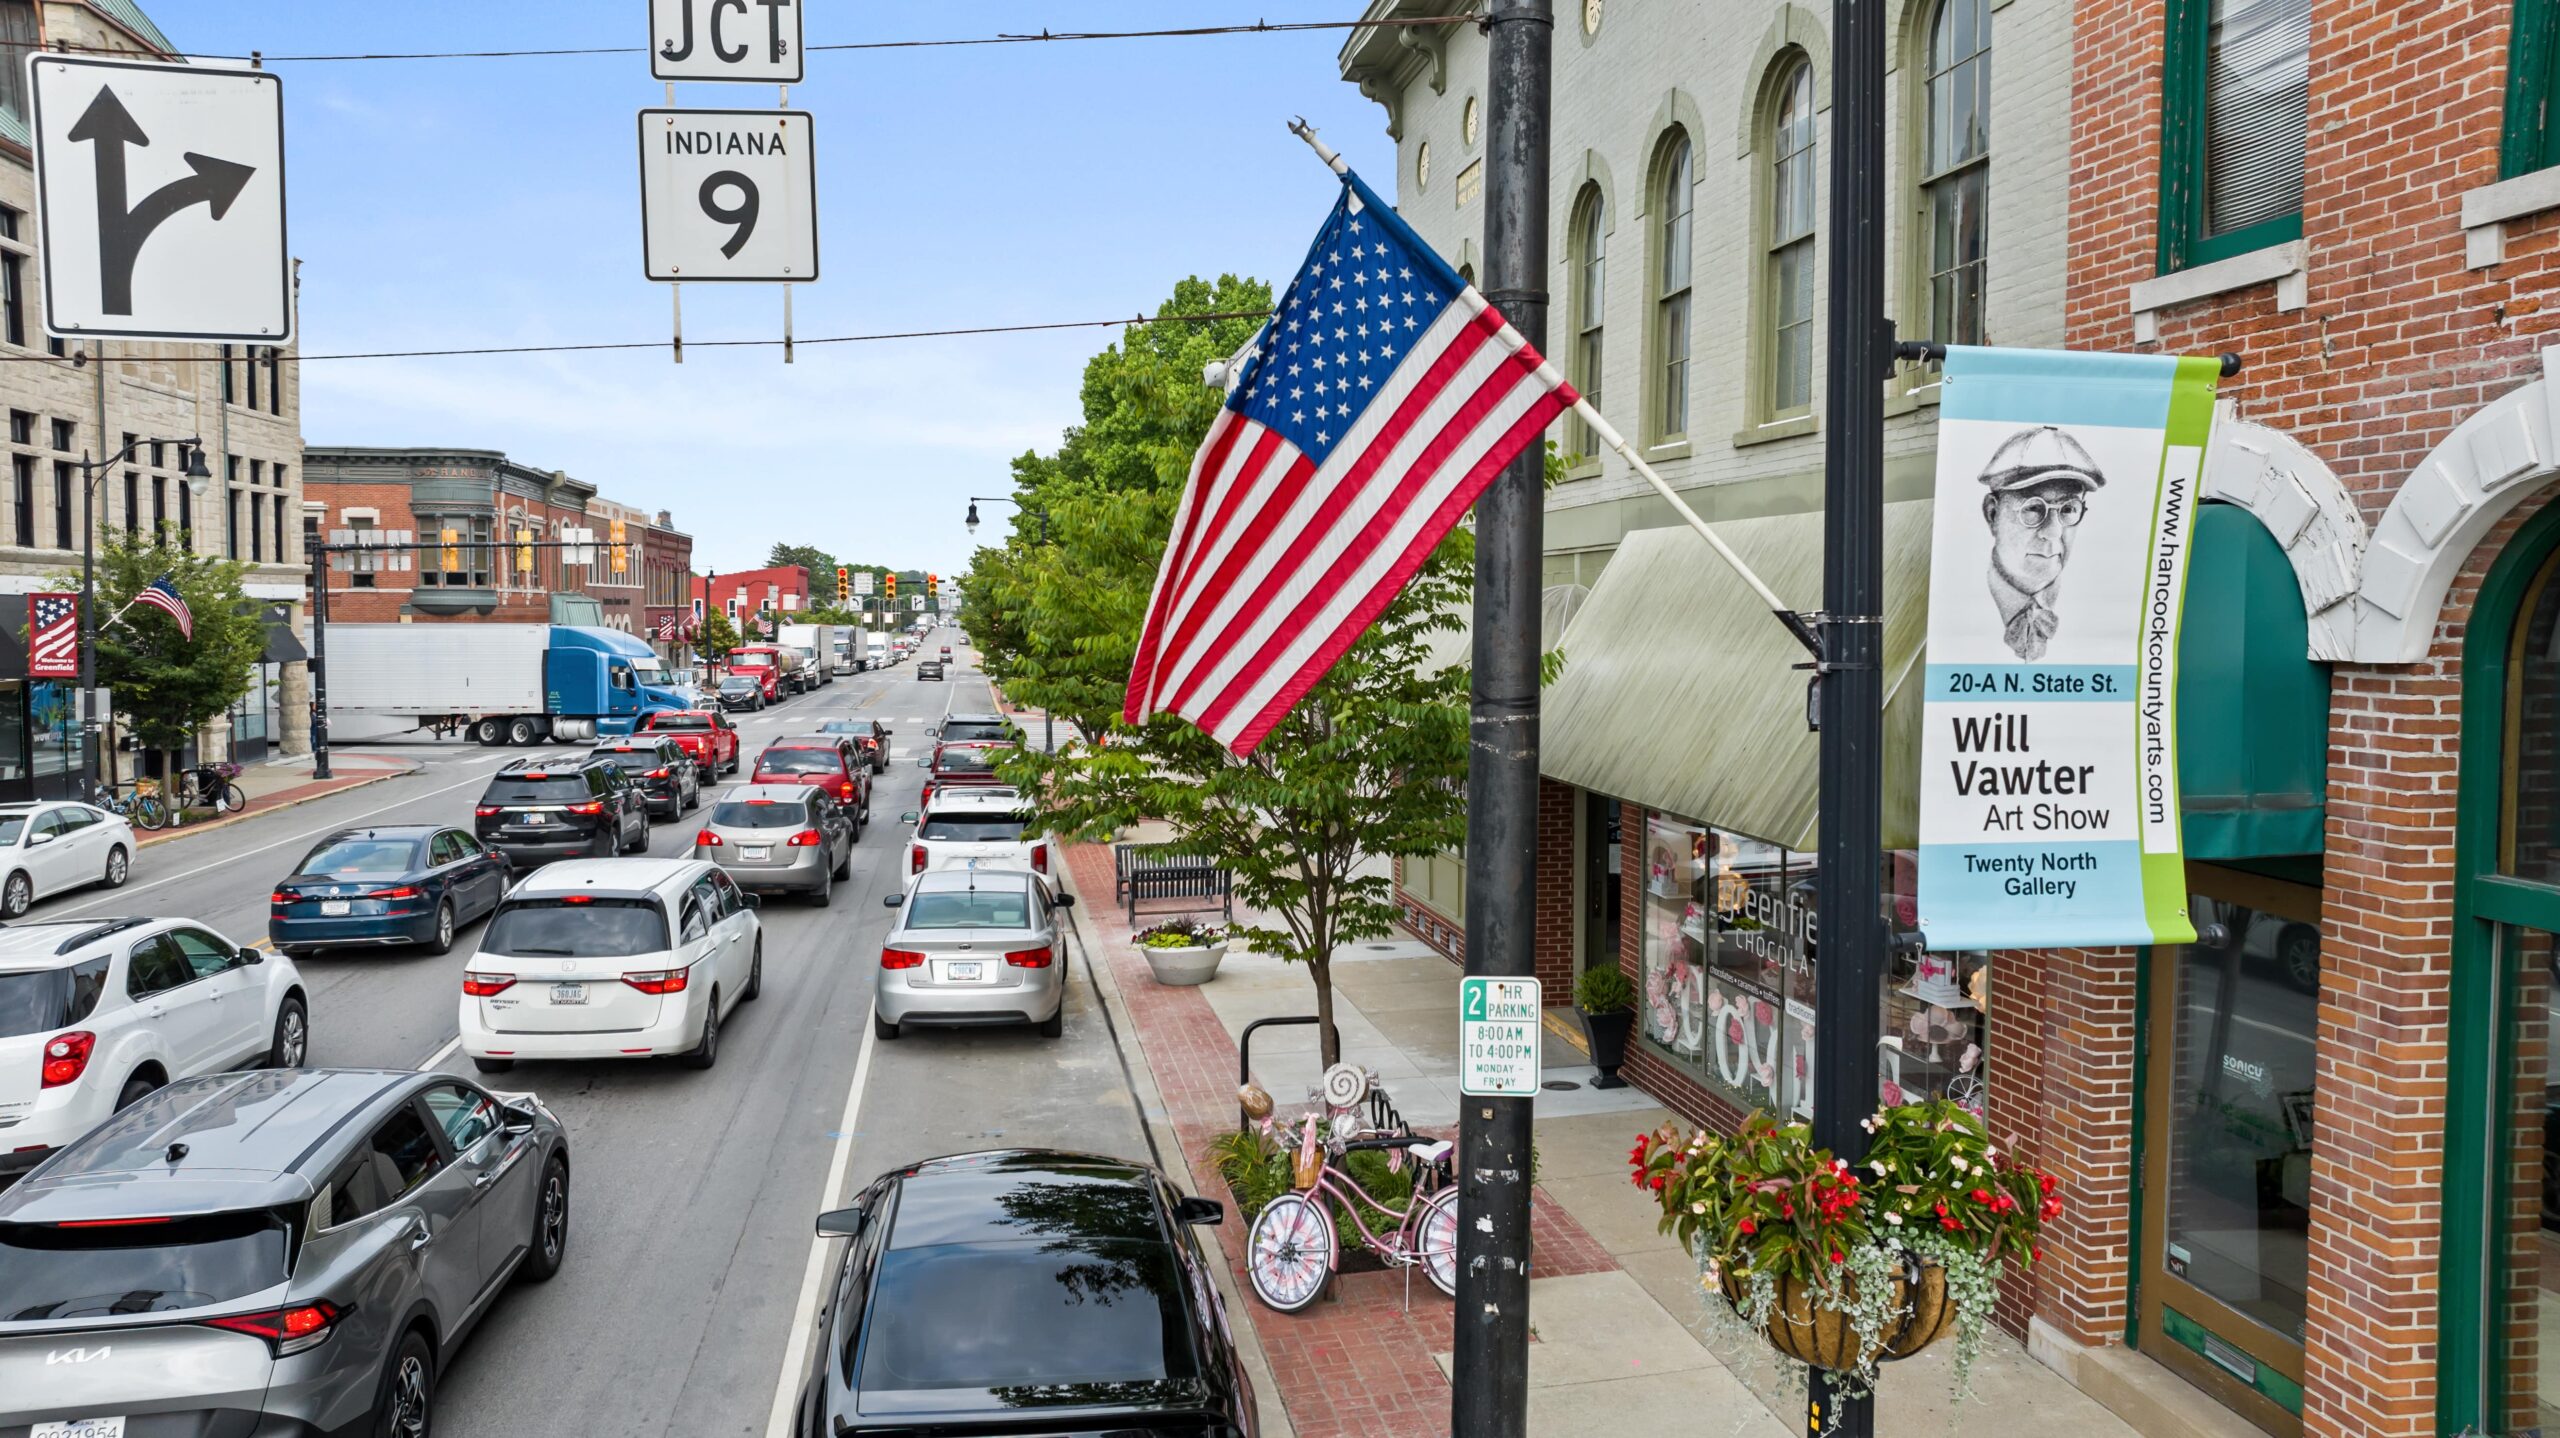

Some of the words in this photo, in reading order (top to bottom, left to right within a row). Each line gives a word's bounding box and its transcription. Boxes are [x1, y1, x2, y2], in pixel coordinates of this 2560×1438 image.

[659, 0, 791, 63] JCT
[666, 131, 786, 155] INDIANA
[698, 170, 760, 260] 9
[2143, 478, 2185, 823] www.hancockcountyarts.com
[1950, 673, 1996, 692] 20-A
[2004, 673, 2024, 692] N.
[2032, 673, 2084, 692] State
[2091, 673, 2117, 692] St.
[1952, 712, 2029, 752] Will
[1950, 760, 2094, 795] Vawter
[1983, 804, 2024, 831] Art
[2033, 803, 2110, 830] Show
[1964, 854, 2034, 876] Twenty
[2042, 852, 2097, 871] North
[2004, 877, 2076, 899] Gallery
[1709, 965, 1734, 984] chocolates
[1737, 979, 1759, 996] caramels
[1468, 986, 1482, 1015] 2
[1503, 985, 1522, 999] HR
[1489, 1003, 1535, 1018] PARKING
[1469, 1044, 1483, 1058] TO
[1487, 1044, 1531, 1059] 4:00PM
[1476, 1064, 1514, 1073] MONDAY
[1483, 1077, 1516, 1086] FRIDAY
[46, 1346, 111, 1365] KIA
